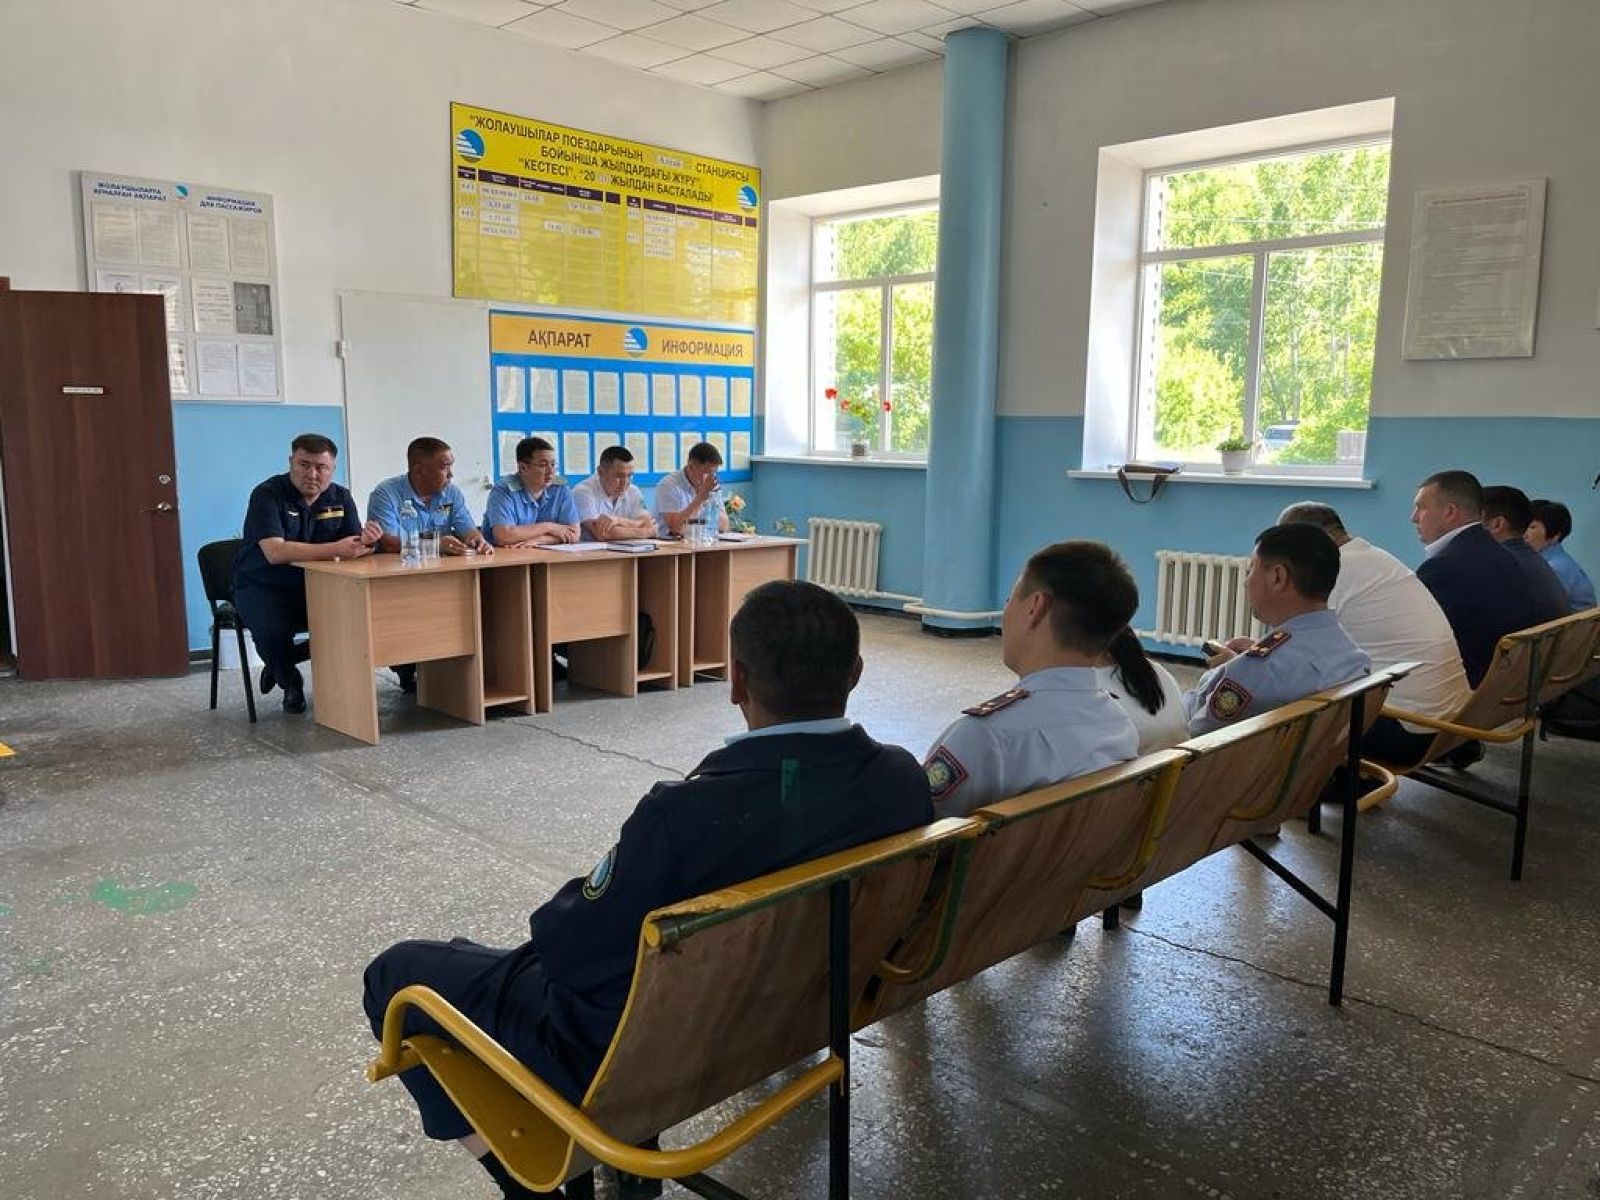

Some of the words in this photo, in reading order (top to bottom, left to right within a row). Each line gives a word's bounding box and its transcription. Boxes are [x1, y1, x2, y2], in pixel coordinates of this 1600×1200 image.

[541, 146, 598, 166] БОЙЫНША
[696, 164, 749, 181] СТАНЦИЯСЫ
[611, 174, 655, 193] ЖЫЛДАН
[527, 328, 592, 349] АҚПАРАТ
[662, 338, 743, 360] ИНФОРМАЦИЯ
